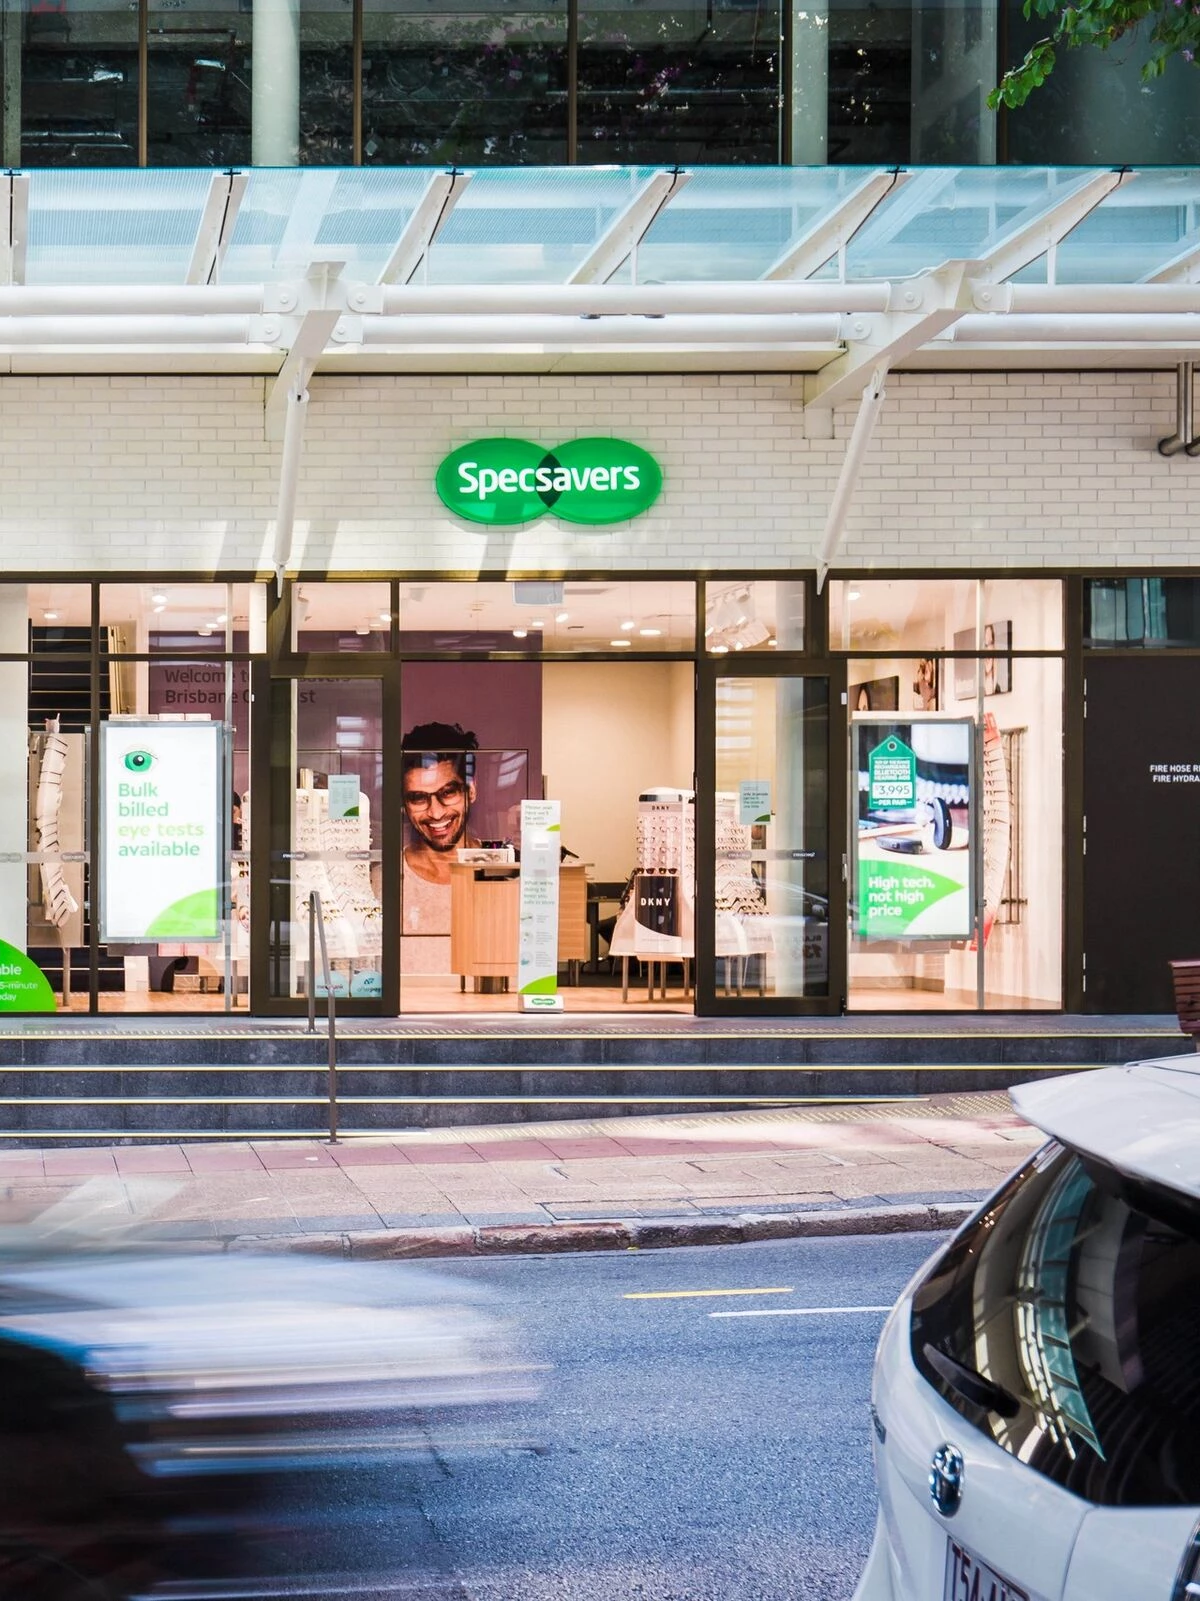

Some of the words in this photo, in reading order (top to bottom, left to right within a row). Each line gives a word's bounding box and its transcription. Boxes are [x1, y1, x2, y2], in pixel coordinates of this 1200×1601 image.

[458, 462, 640, 500] Specsavers
[165, 669, 235, 683] Welcom
[1150, 764, 1168, 772] FIRE
[1170, 764, 1191, 772] HOSE
[118, 782, 159, 797] Bulk
[118, 801, 169, 817] billed
[118, 825, 151, 840] eye
[157, 823, 205, 836] tests
[118, 841, 201, 857] available
[869, 876, 899, 890] High
[640, 897, 671, 907] DKNY
[869, 892, 892, 902] not
[895, 890, 924, 904] high
[869, 904, 902, 918] price
